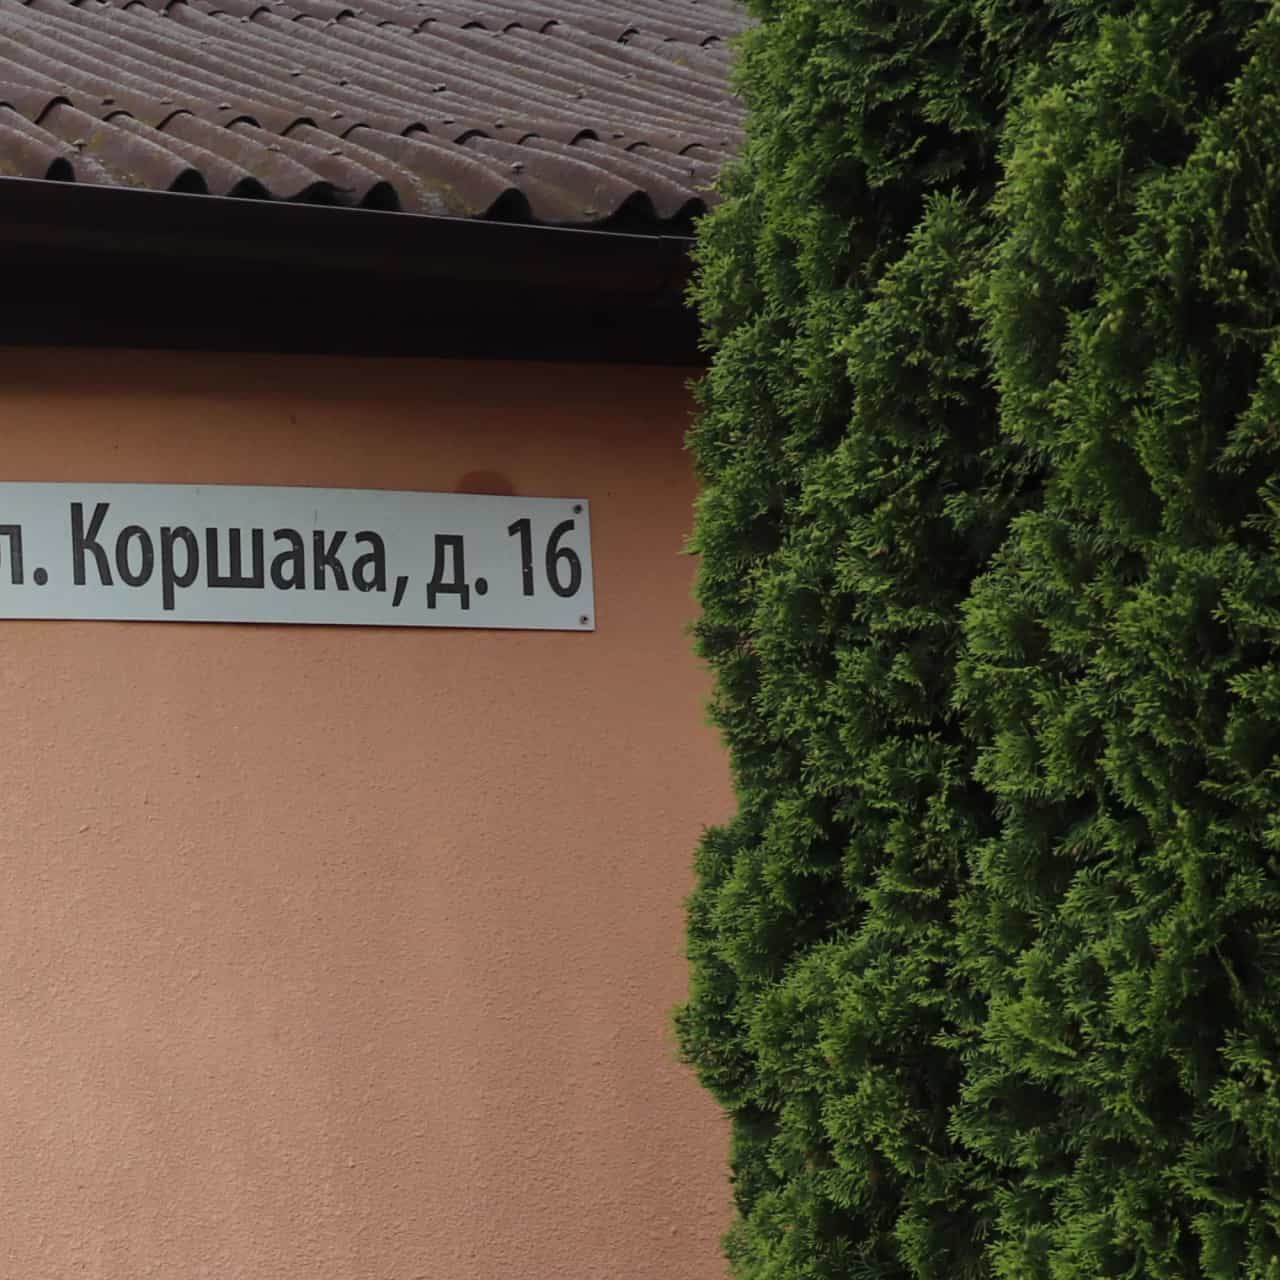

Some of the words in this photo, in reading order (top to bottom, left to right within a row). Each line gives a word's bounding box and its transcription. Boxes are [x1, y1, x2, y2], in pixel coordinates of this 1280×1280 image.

[68, 501, 411, 611] Коршака,
[425, 532, 490, 611] д.
[506, 518, 584, 599] 16
